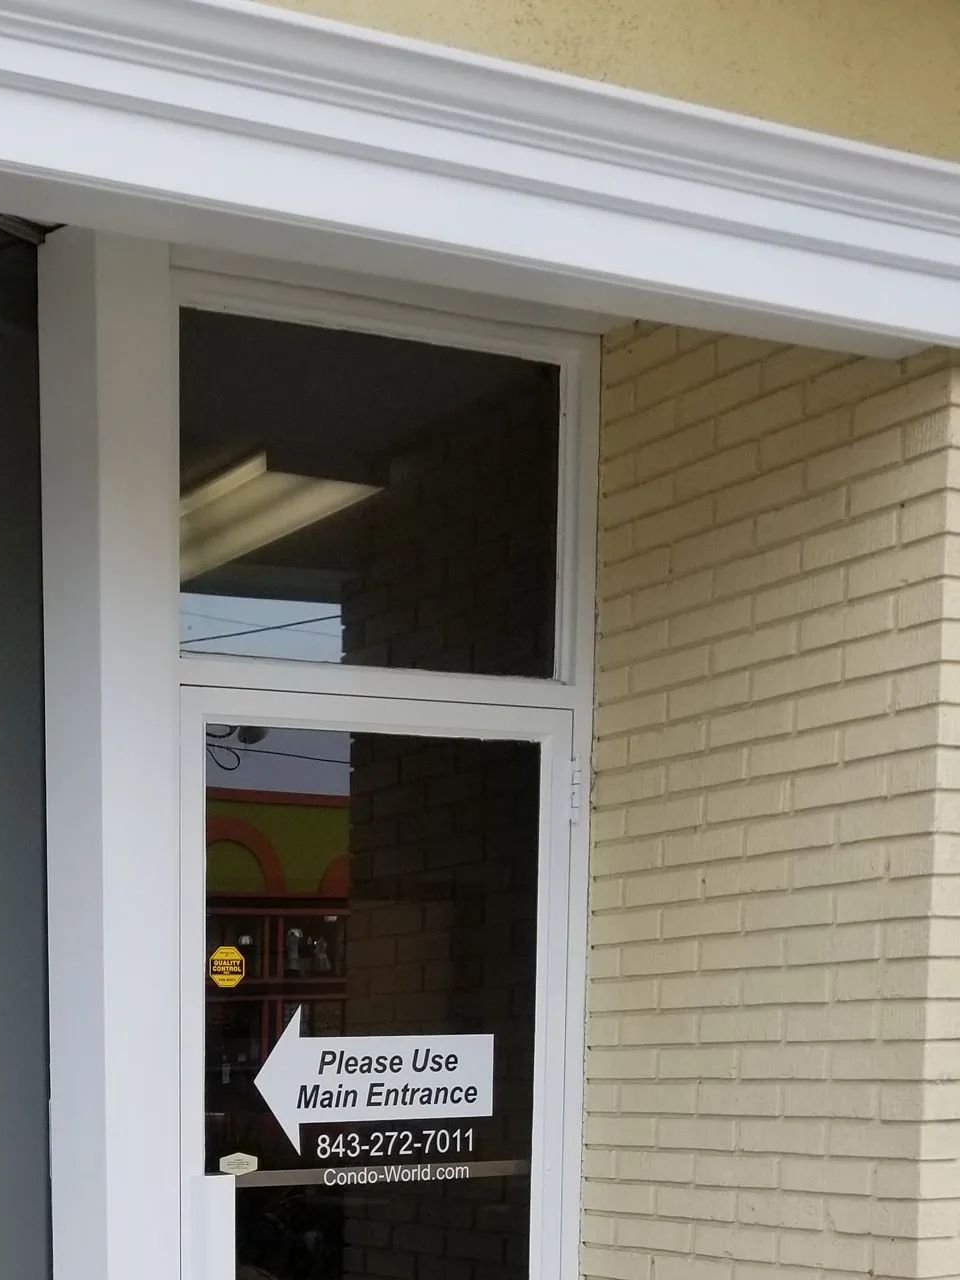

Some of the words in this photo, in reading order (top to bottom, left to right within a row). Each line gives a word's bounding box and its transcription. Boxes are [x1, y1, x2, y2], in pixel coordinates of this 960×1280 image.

[213, 959, 241, 967] QUALITY
[318, 1049, 403, 1075] Please
[411, 1048, 459, 1073] Use
[296, 1083, 358, 1109] Main
[366, 1082, 478, 1107] Entrance
[316, 1128, 474, 1159] 843-272-7011
[323, 1164, 470, 1186] Condo-World.com
